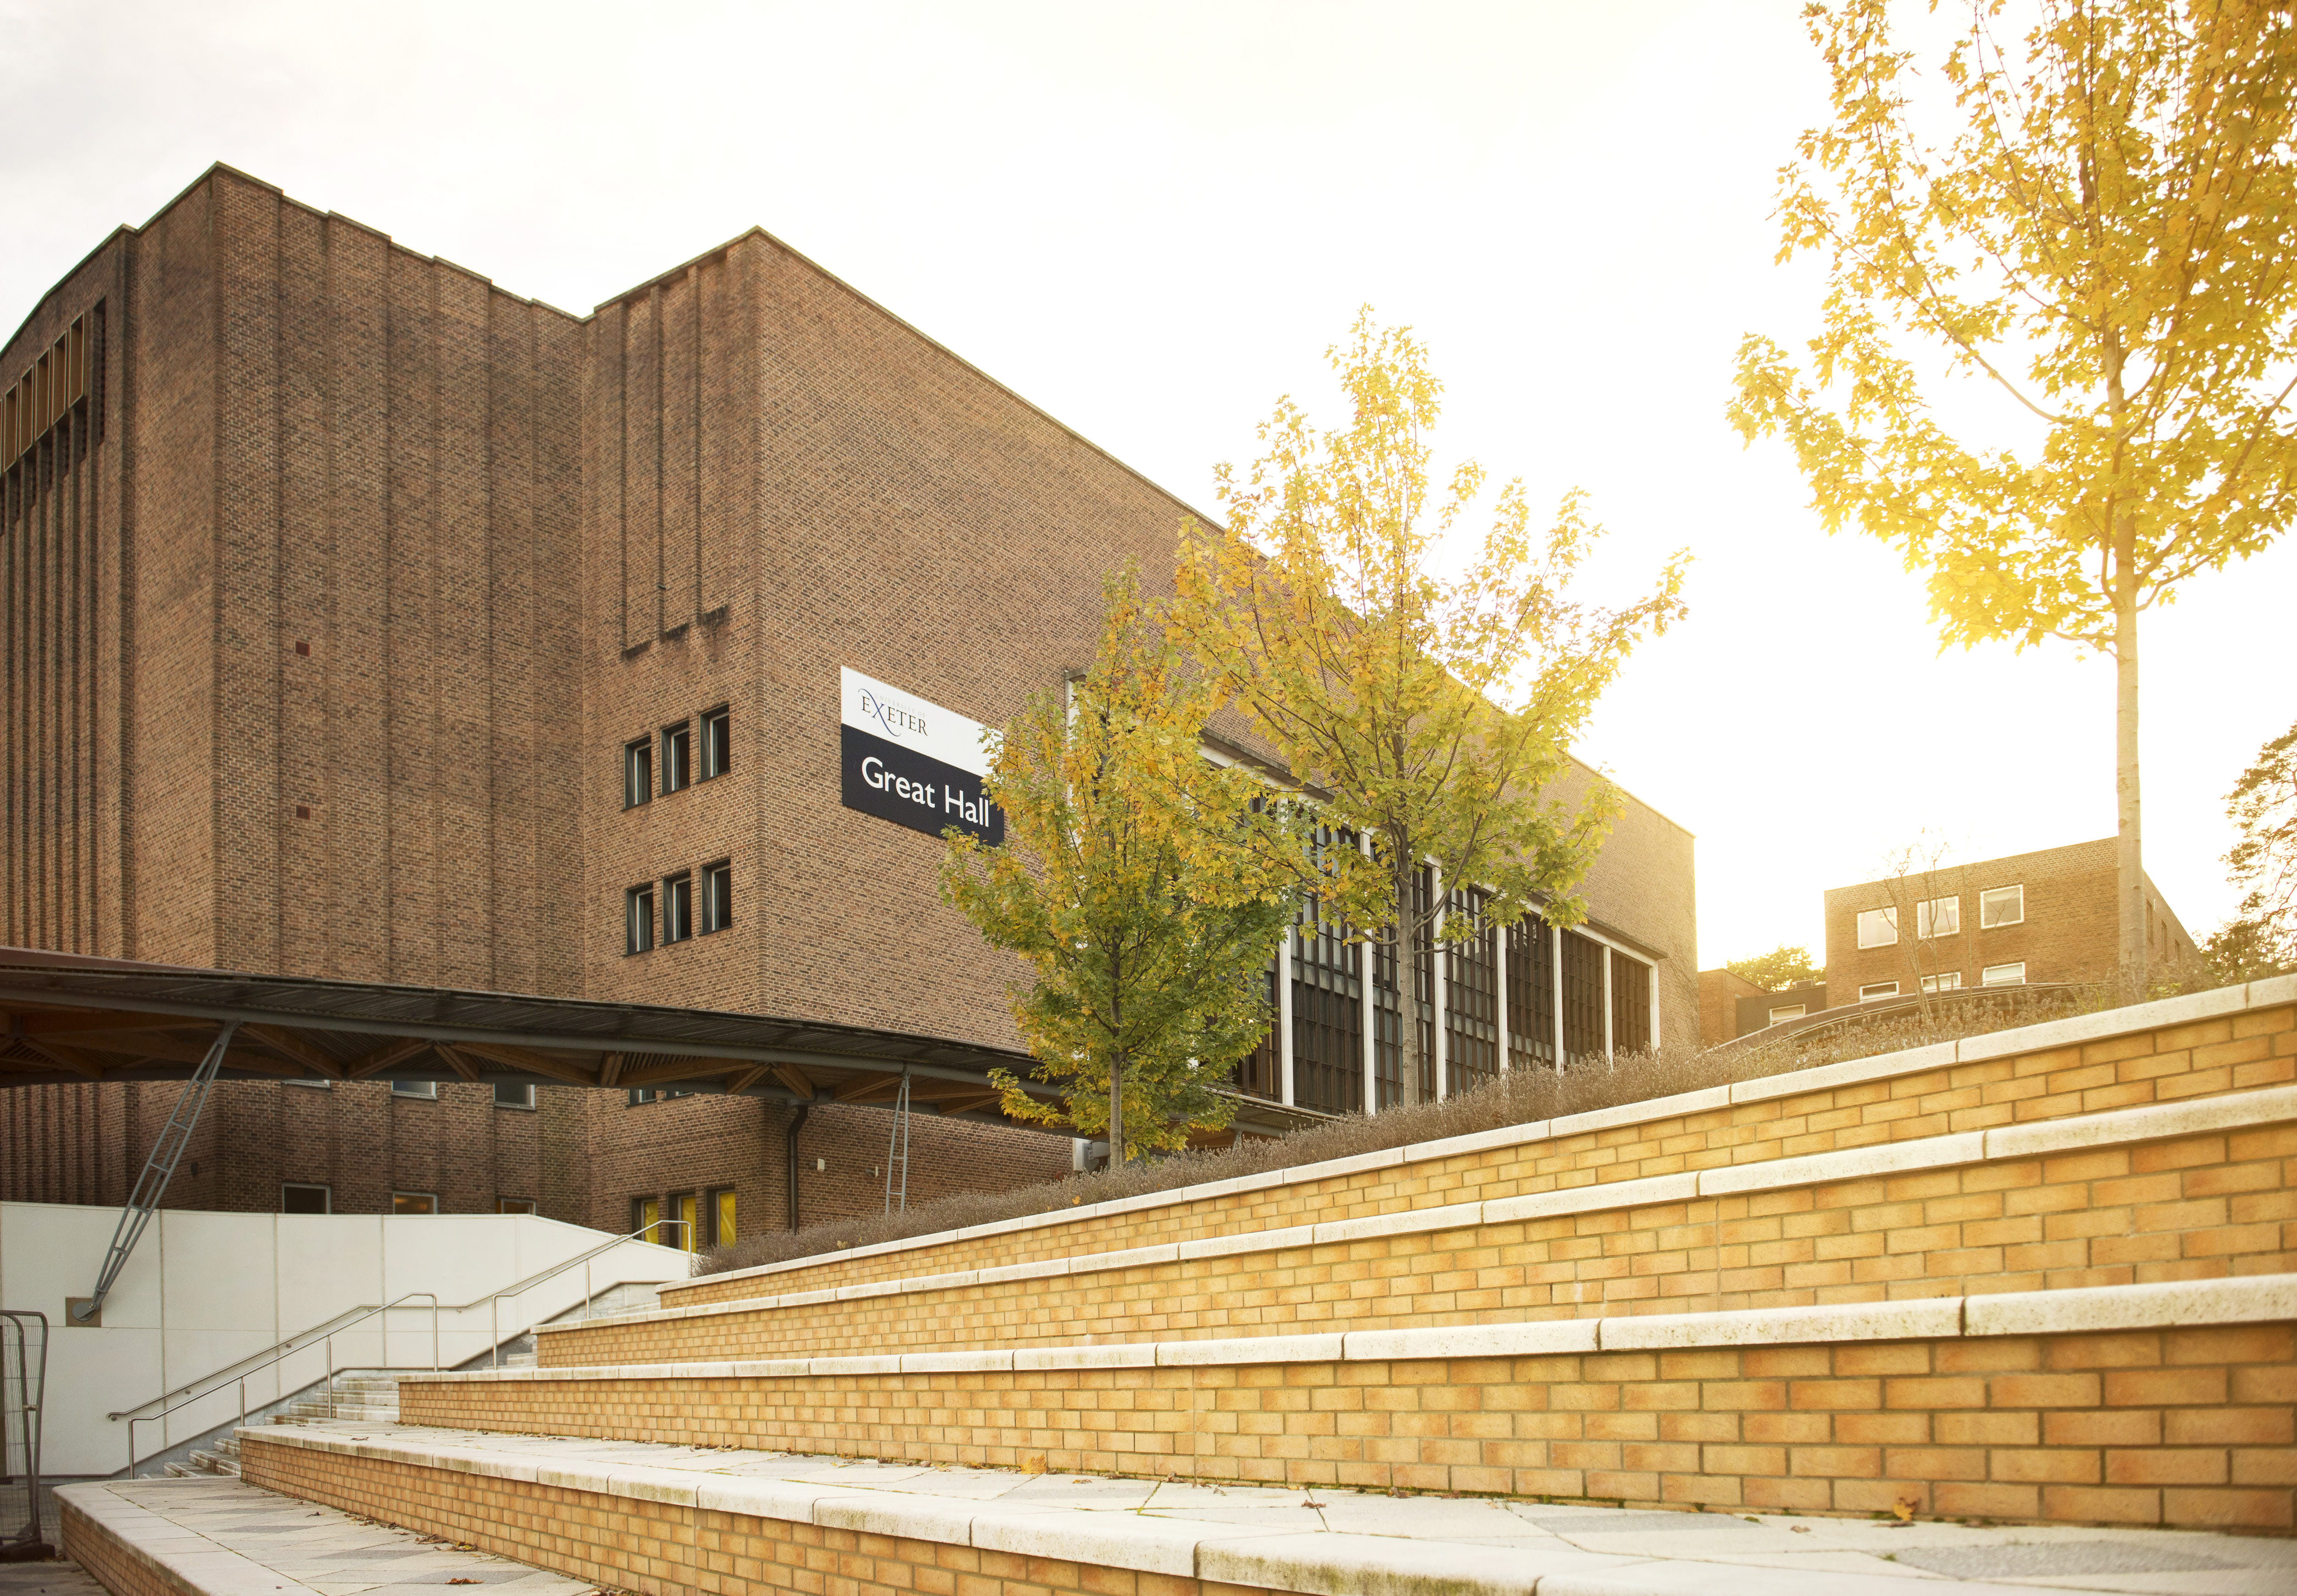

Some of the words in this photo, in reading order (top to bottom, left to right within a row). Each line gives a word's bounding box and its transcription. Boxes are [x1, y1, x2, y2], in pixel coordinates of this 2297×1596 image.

[858, 689, 928, 736] EXETER
[875, 693, 915, 713] UNIVERSITY
[861, 757, 935, 808] Great
[945, 785, 989, 827] Hall
